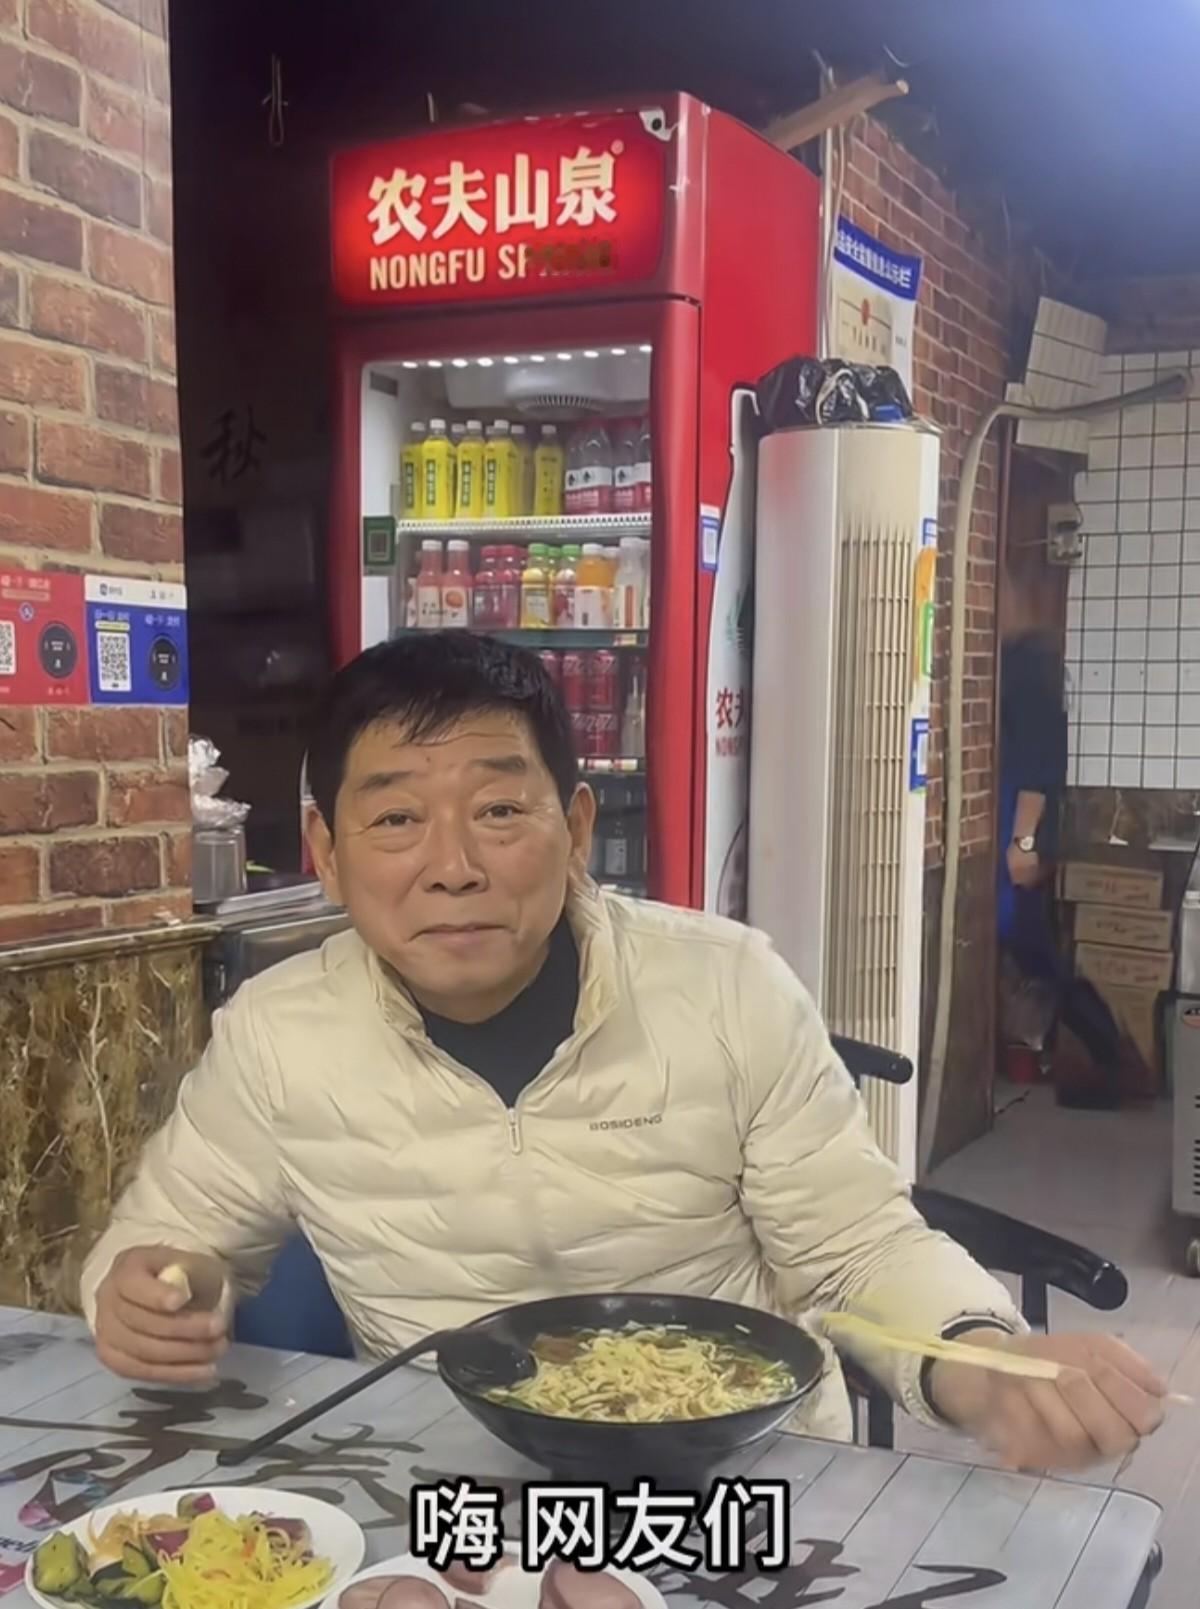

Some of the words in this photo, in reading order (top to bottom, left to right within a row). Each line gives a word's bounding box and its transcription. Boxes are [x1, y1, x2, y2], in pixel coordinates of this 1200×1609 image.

[367, 146, 617, 246] 农夫山泉
[370, 247, 486, 291] NONGFU
